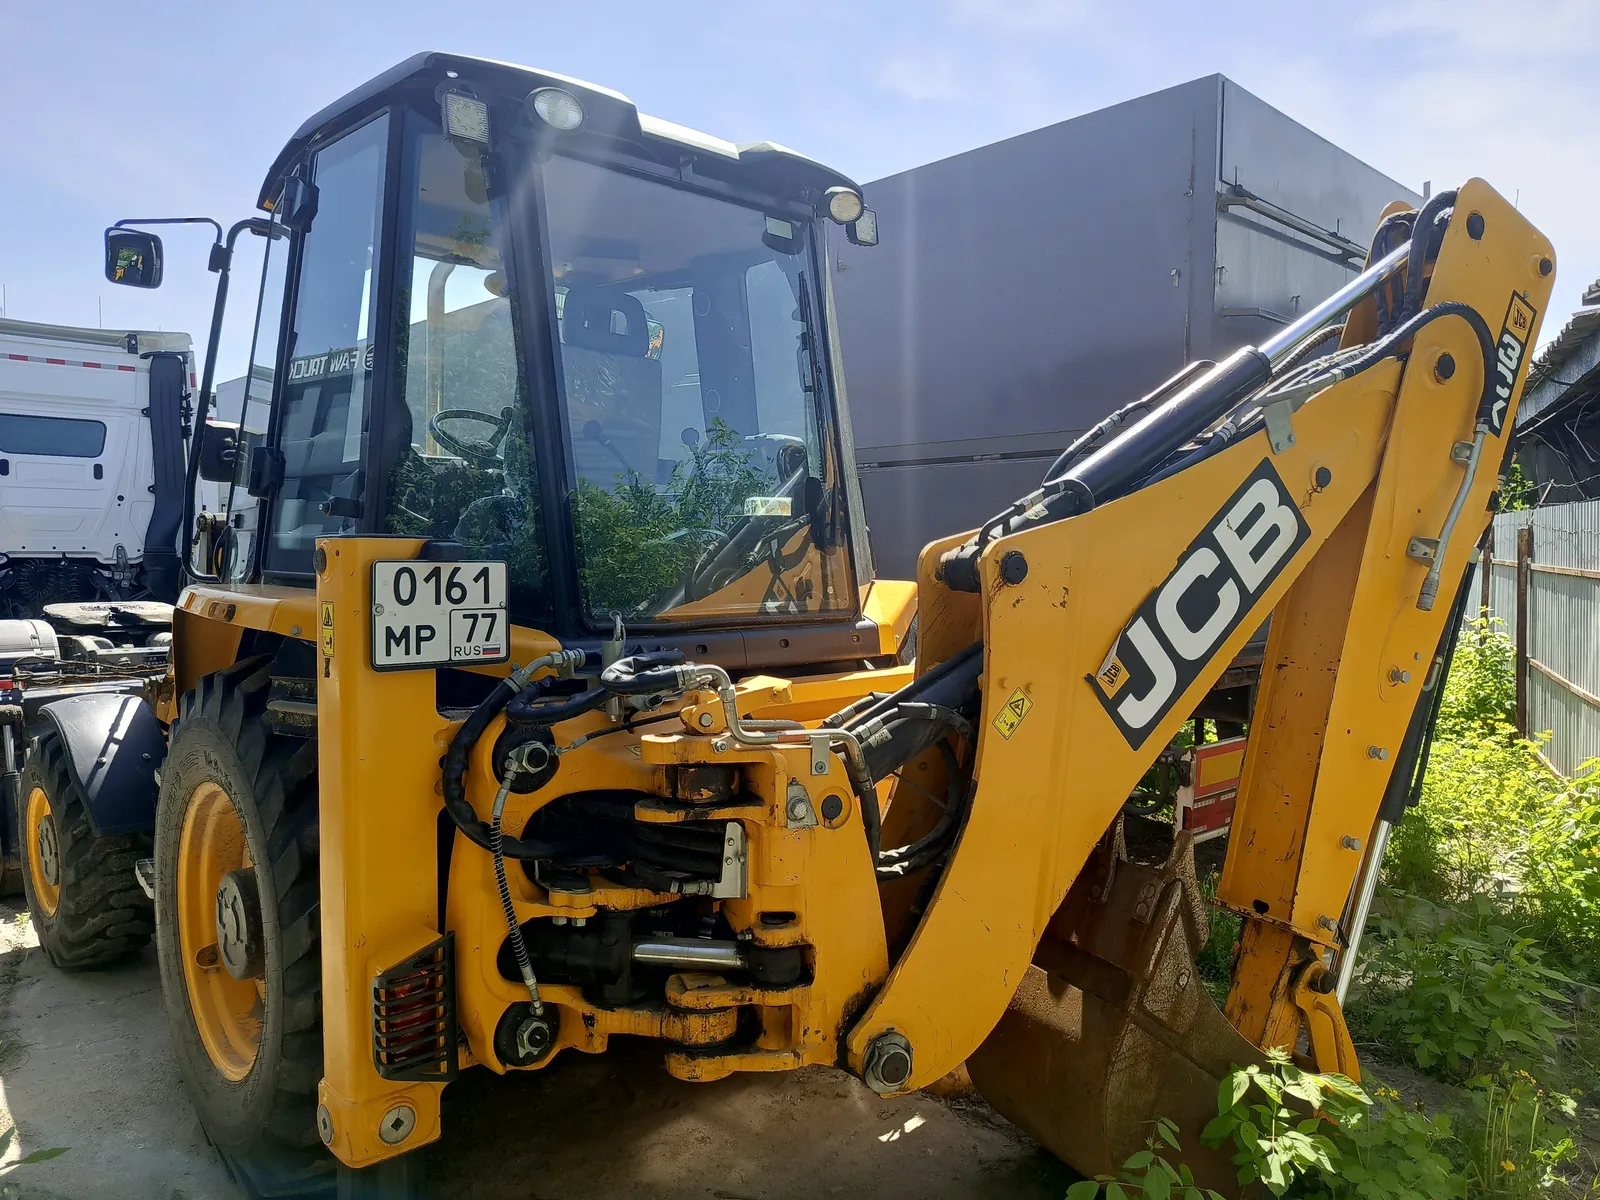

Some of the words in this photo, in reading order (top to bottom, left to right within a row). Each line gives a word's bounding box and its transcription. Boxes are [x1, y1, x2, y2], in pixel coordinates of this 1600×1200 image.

[393, 566, 490, 606] 0161
[1117, 479, 1298, 729] JCB
[385, 625, 436, 657] MP
[462, 613, 497, 643] 77
[454, 645, 481, 657] RUS
[1102, 664, 1120, 685] JCB
